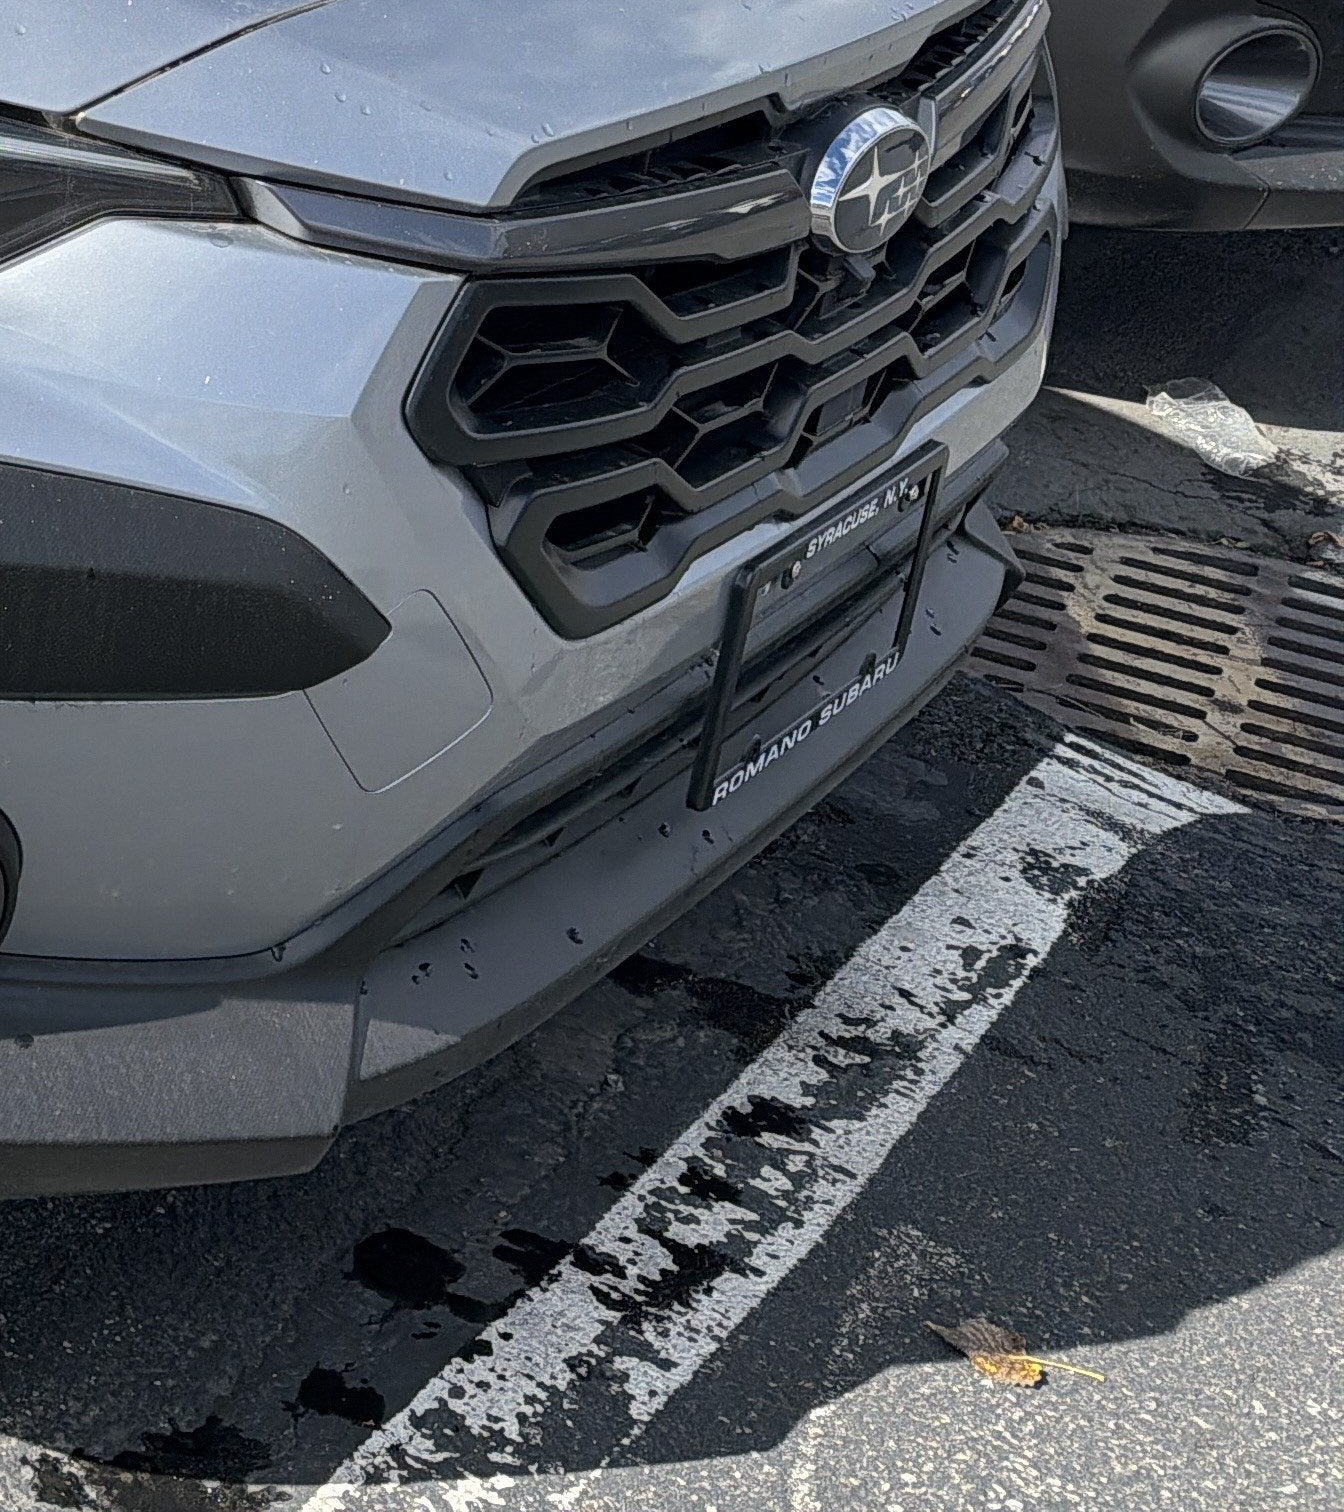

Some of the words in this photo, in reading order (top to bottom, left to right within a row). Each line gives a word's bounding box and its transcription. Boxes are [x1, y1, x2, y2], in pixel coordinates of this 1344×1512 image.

[806, 498, 880, 559] SYRACUSE,
[712, 720, 812, 806] ROMANO
[819, 652, 900, 725] SUBARU
